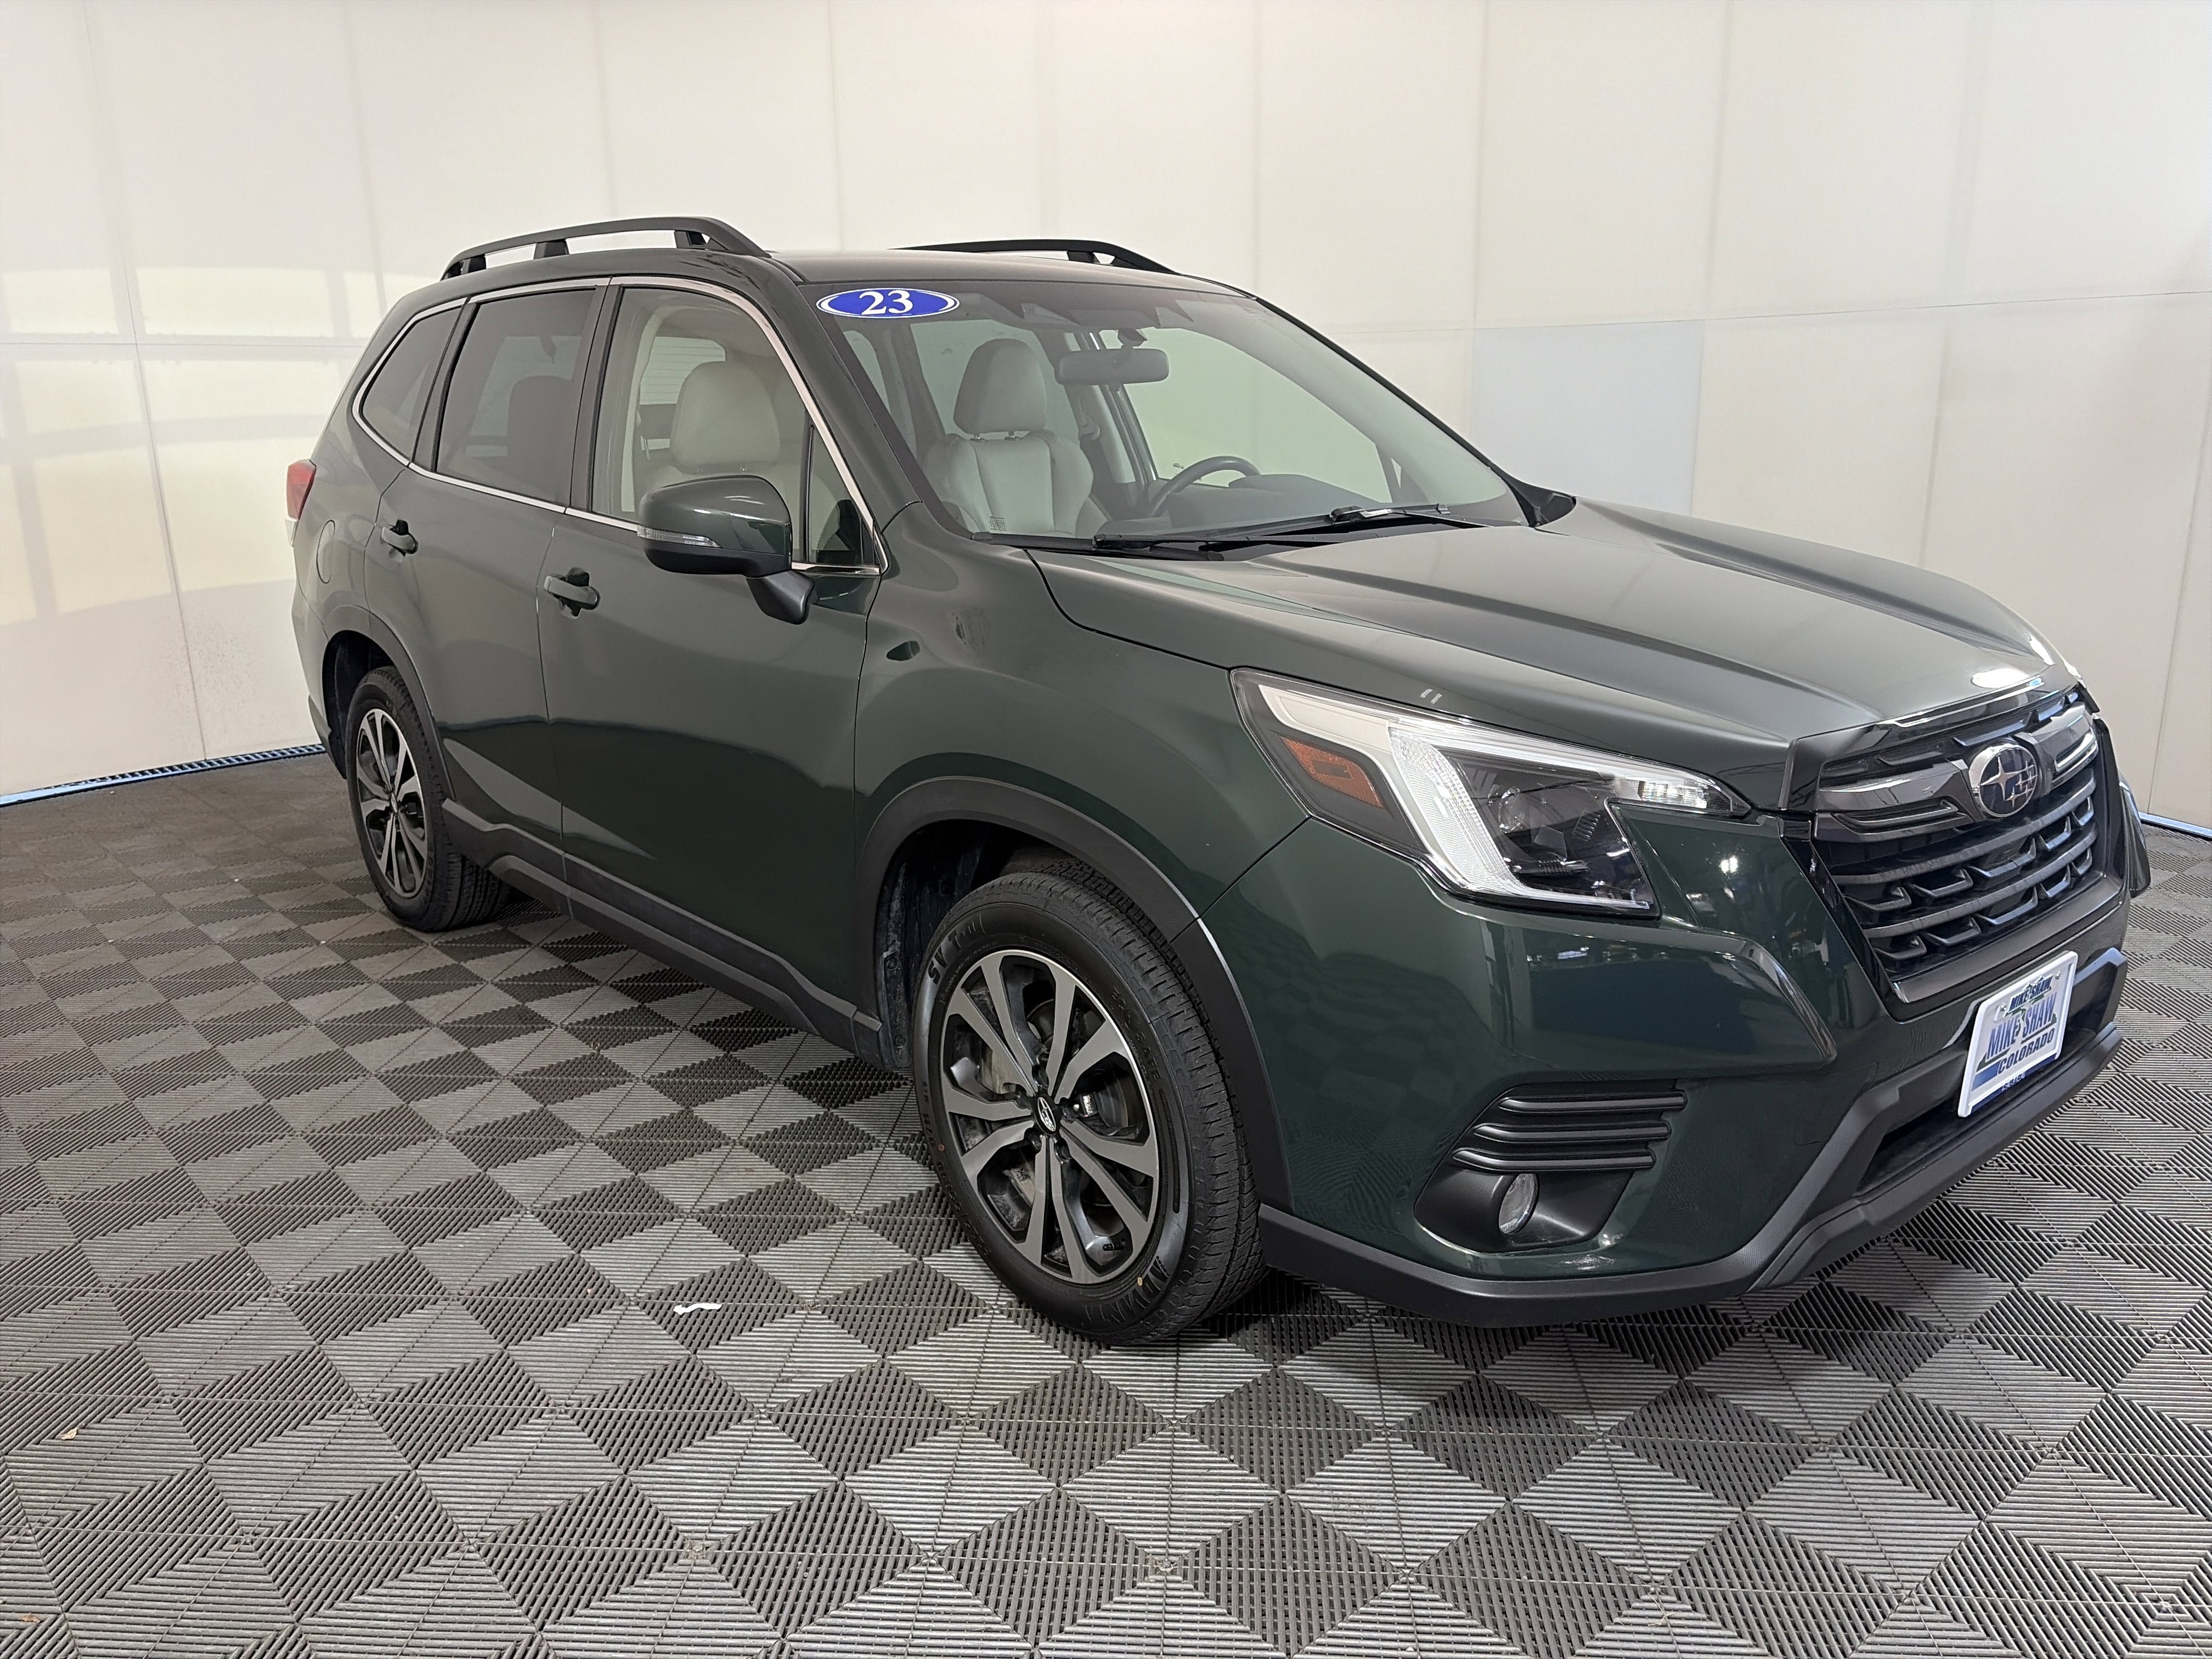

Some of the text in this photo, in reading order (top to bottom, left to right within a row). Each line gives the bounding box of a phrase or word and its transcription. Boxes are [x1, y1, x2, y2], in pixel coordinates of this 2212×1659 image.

[859, 290, 913, 315] 23
[2009, 975, 2053, 1012] MIKE SHAW
[1987, 992, 2057, 1060] MIKE SHAW
[1998, 1028, 2055, 1074] COLORADO
